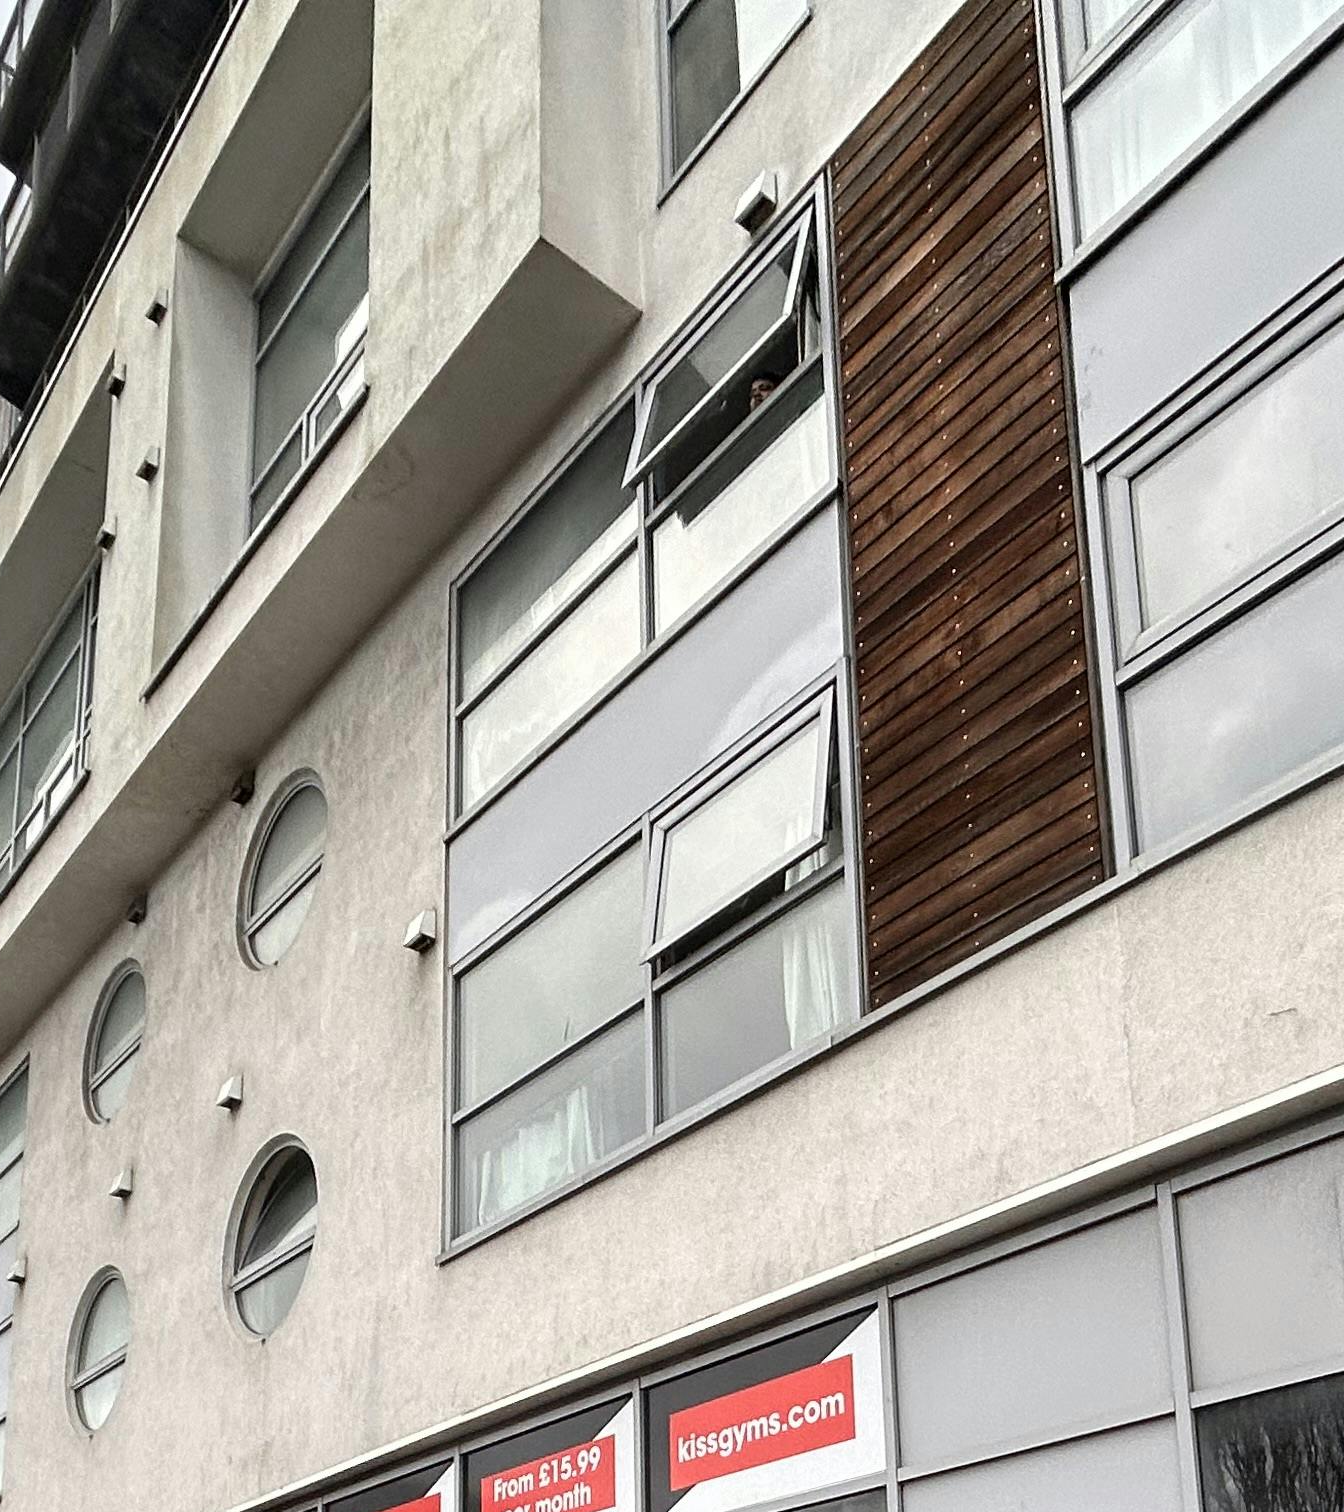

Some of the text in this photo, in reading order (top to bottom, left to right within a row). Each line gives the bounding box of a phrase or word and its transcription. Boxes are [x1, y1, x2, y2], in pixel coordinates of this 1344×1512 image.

[676, 1391, 846, 1464] kissgyms.com
[492, 1446, 602, 1503] From £15.99
